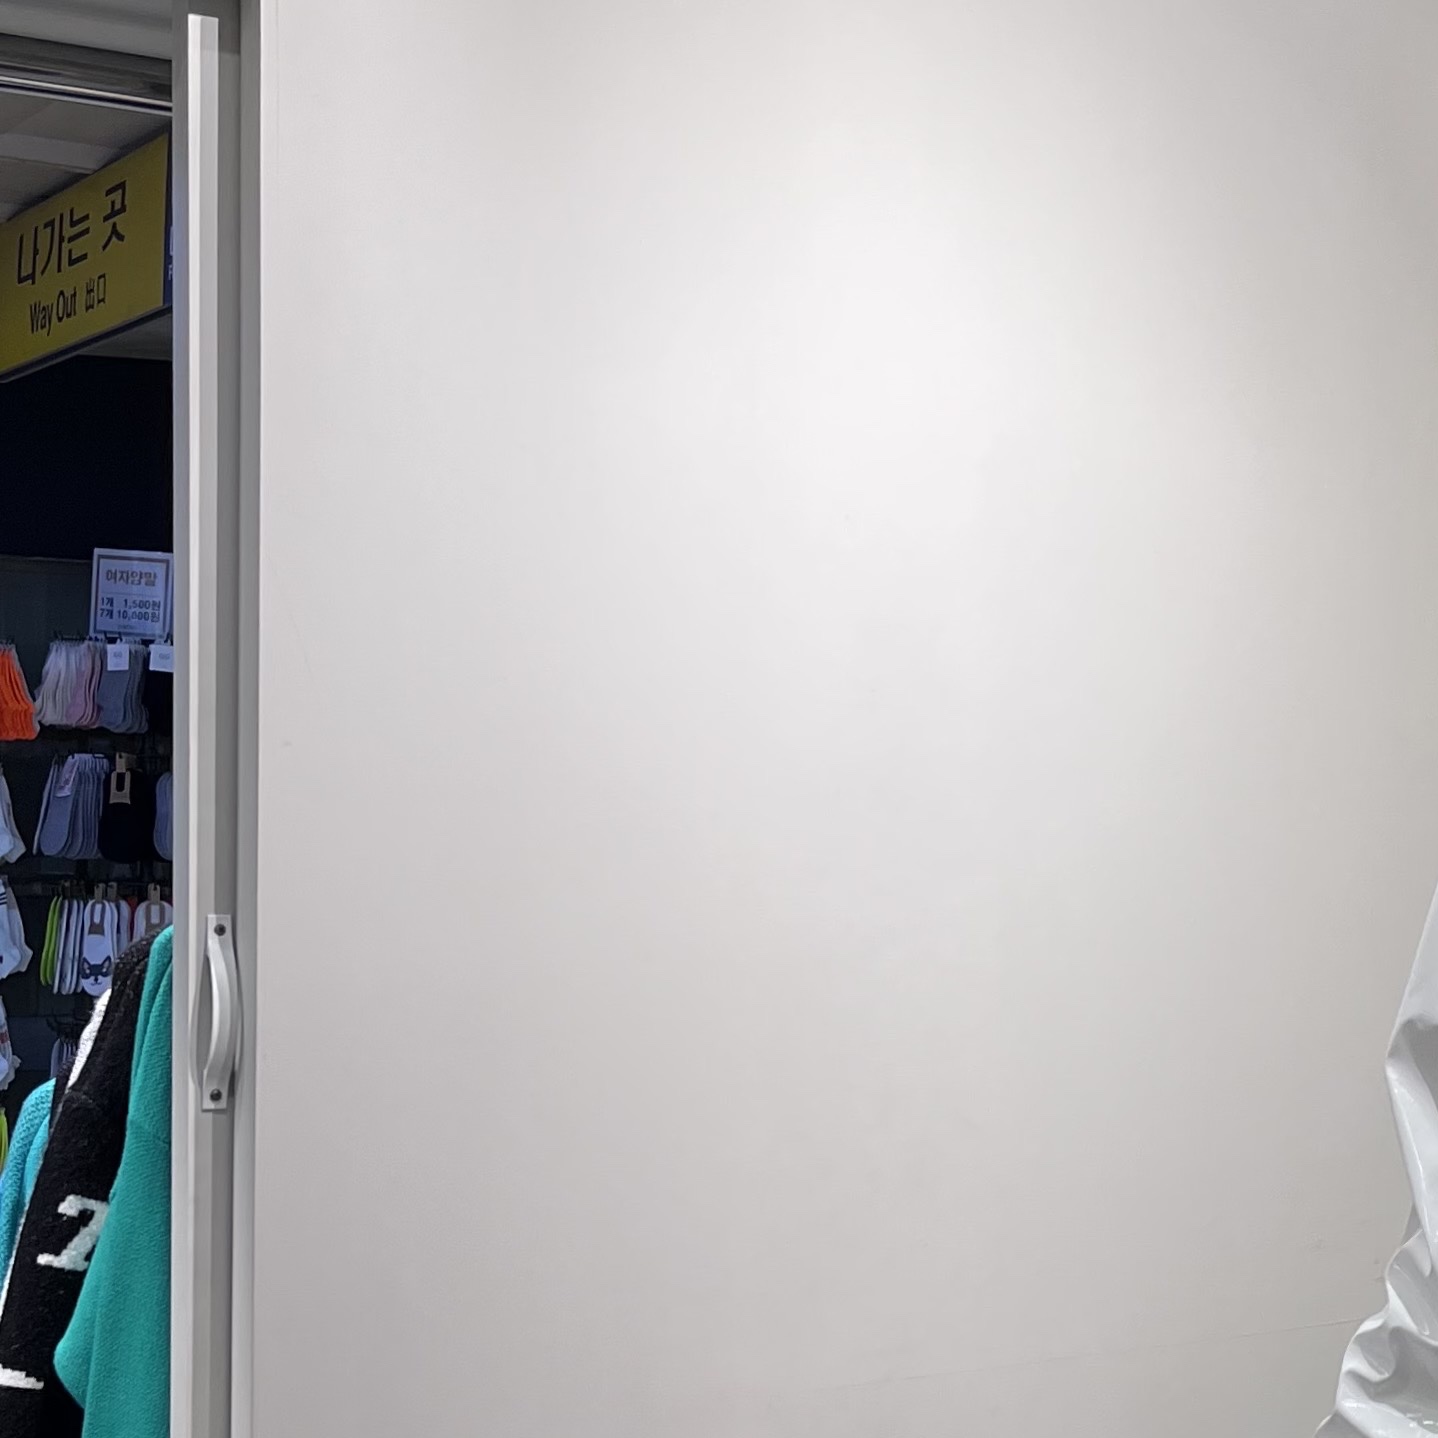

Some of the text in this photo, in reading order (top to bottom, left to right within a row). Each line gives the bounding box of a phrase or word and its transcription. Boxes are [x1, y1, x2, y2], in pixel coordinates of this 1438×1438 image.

[17, 207, 91, 286] 나가는
[102, 180, 128, 251] 곳
[29, 273, 107, 337] Way Out 出口
[105, 569, 157, 587] 여자양말
